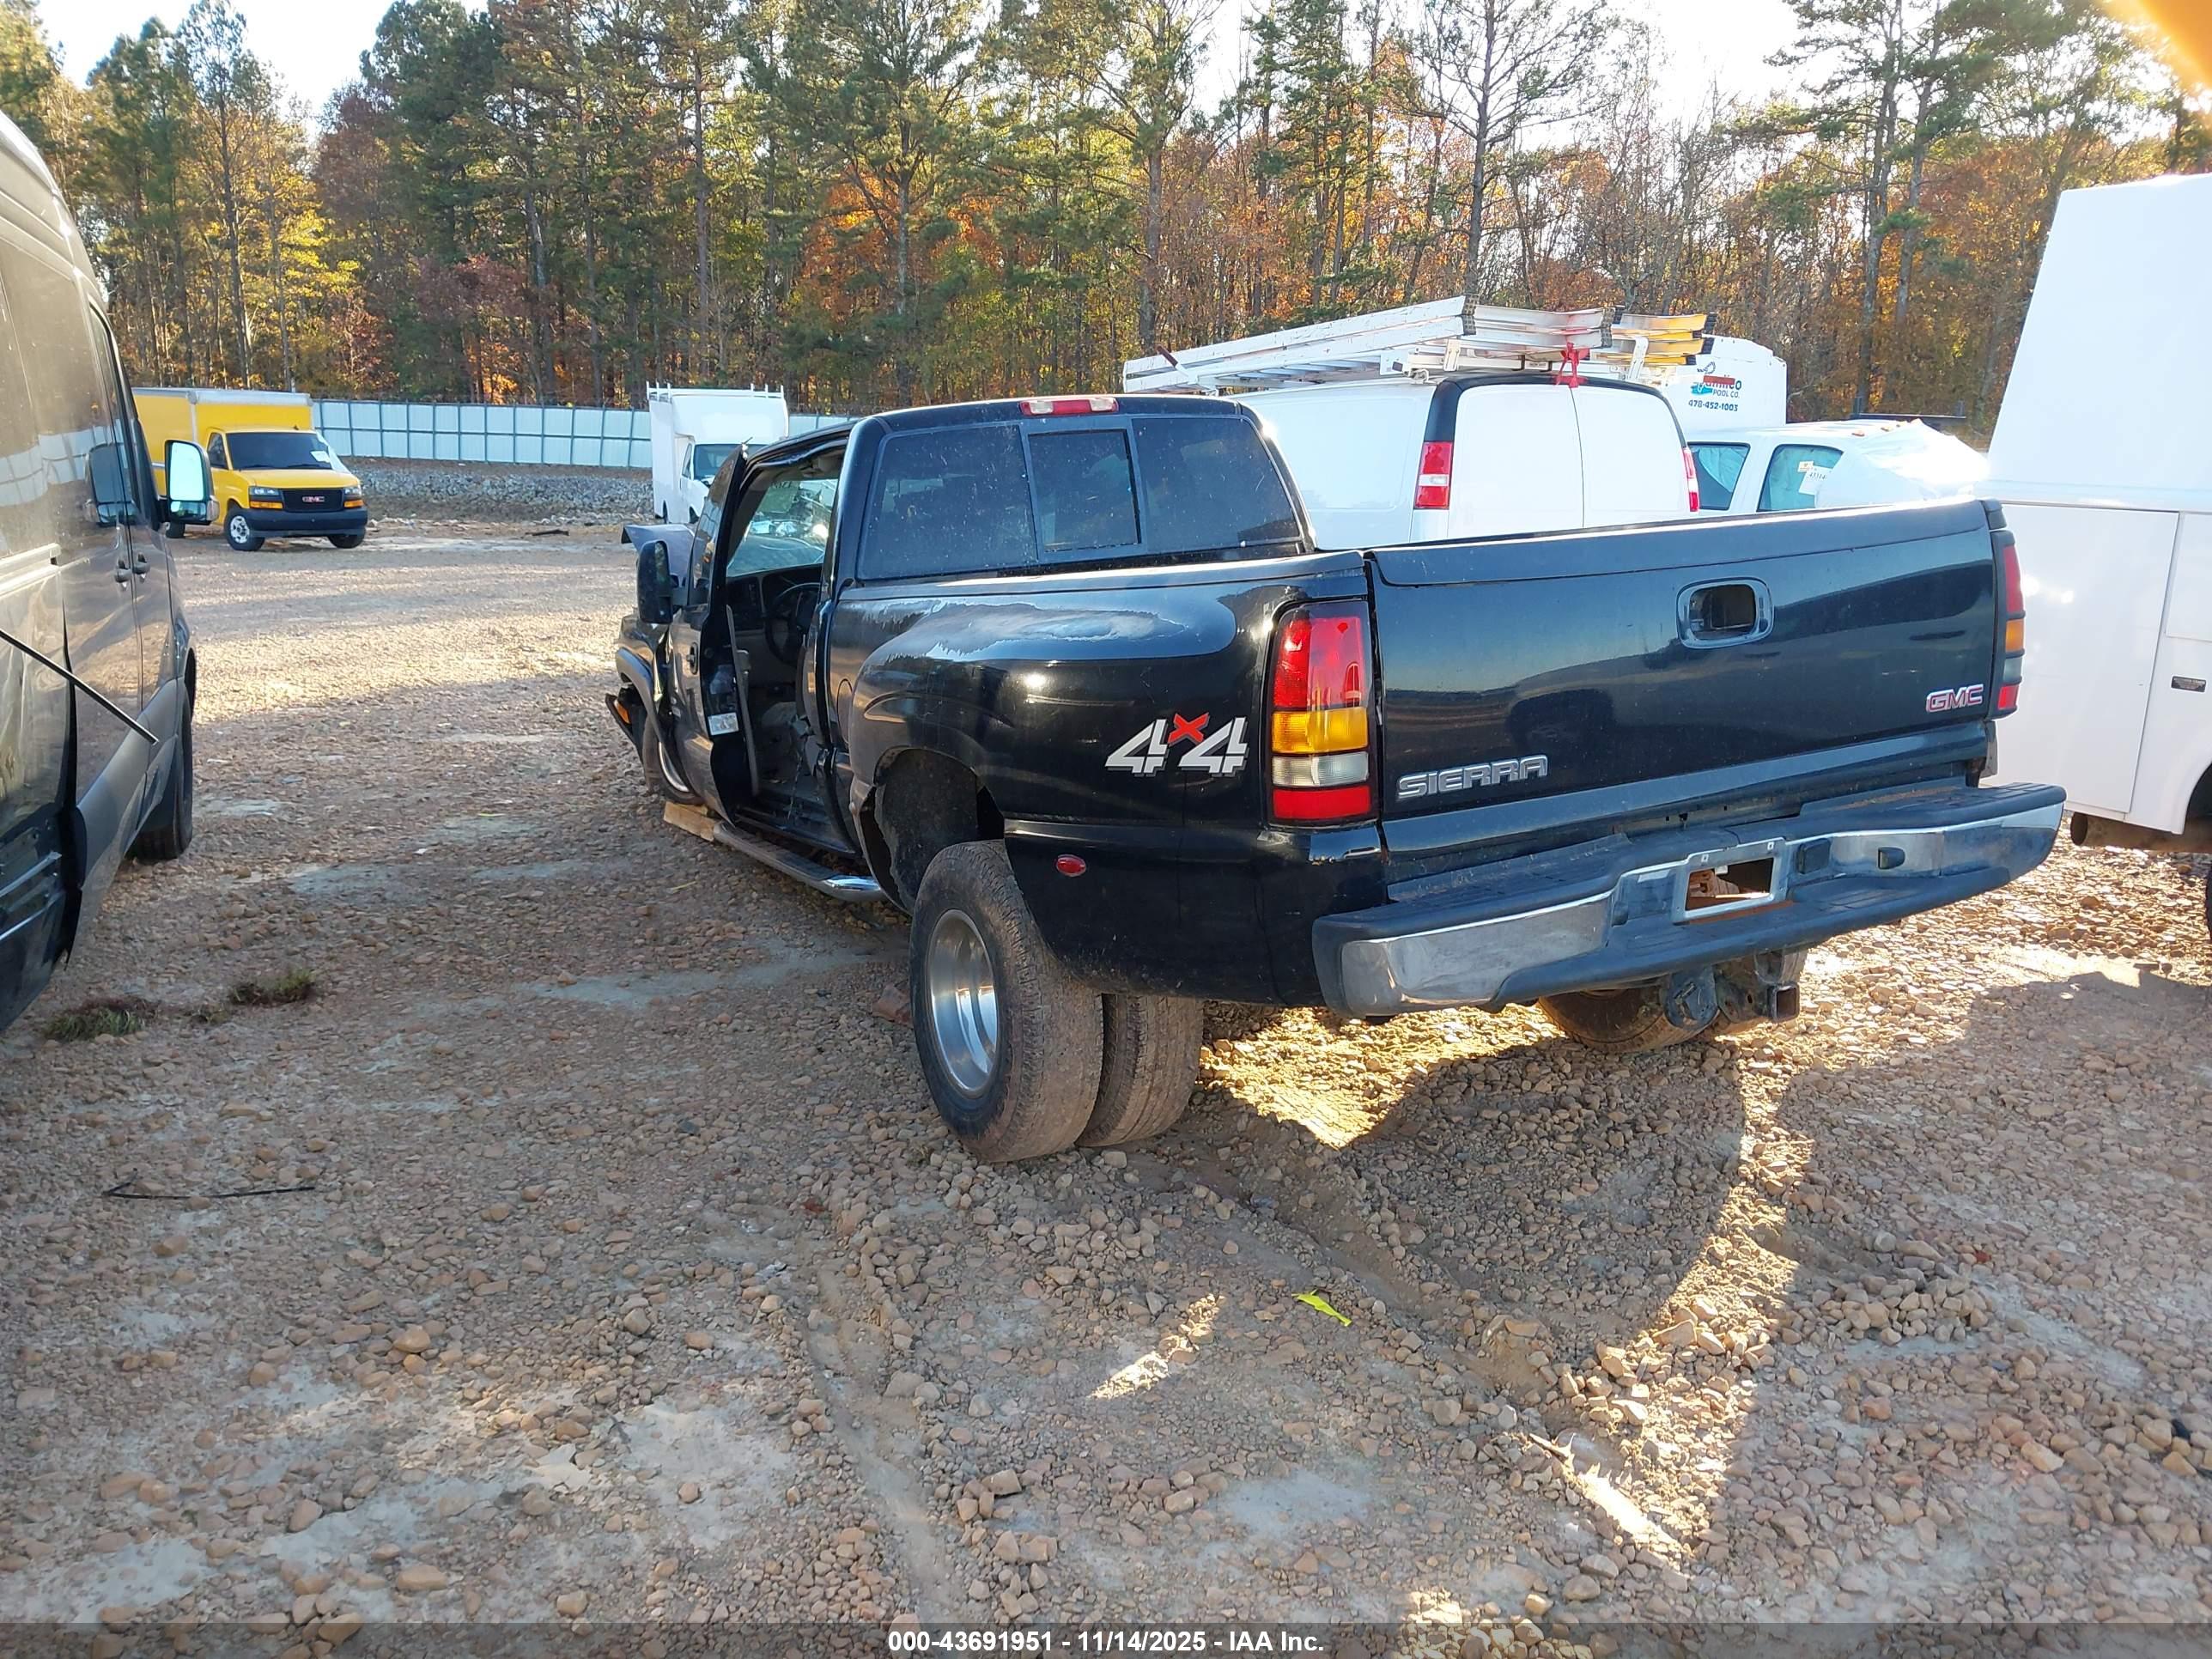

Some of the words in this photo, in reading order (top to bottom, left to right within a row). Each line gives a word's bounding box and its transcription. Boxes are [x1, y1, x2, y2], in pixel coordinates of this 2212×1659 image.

[1713, 389, 1729, 398] POOL
[1688, 399, 1738, 412] 478-452-1003
[1926, 684, 1984, 713] GMC
[1397, 754, 1548, 799] SIERRA
